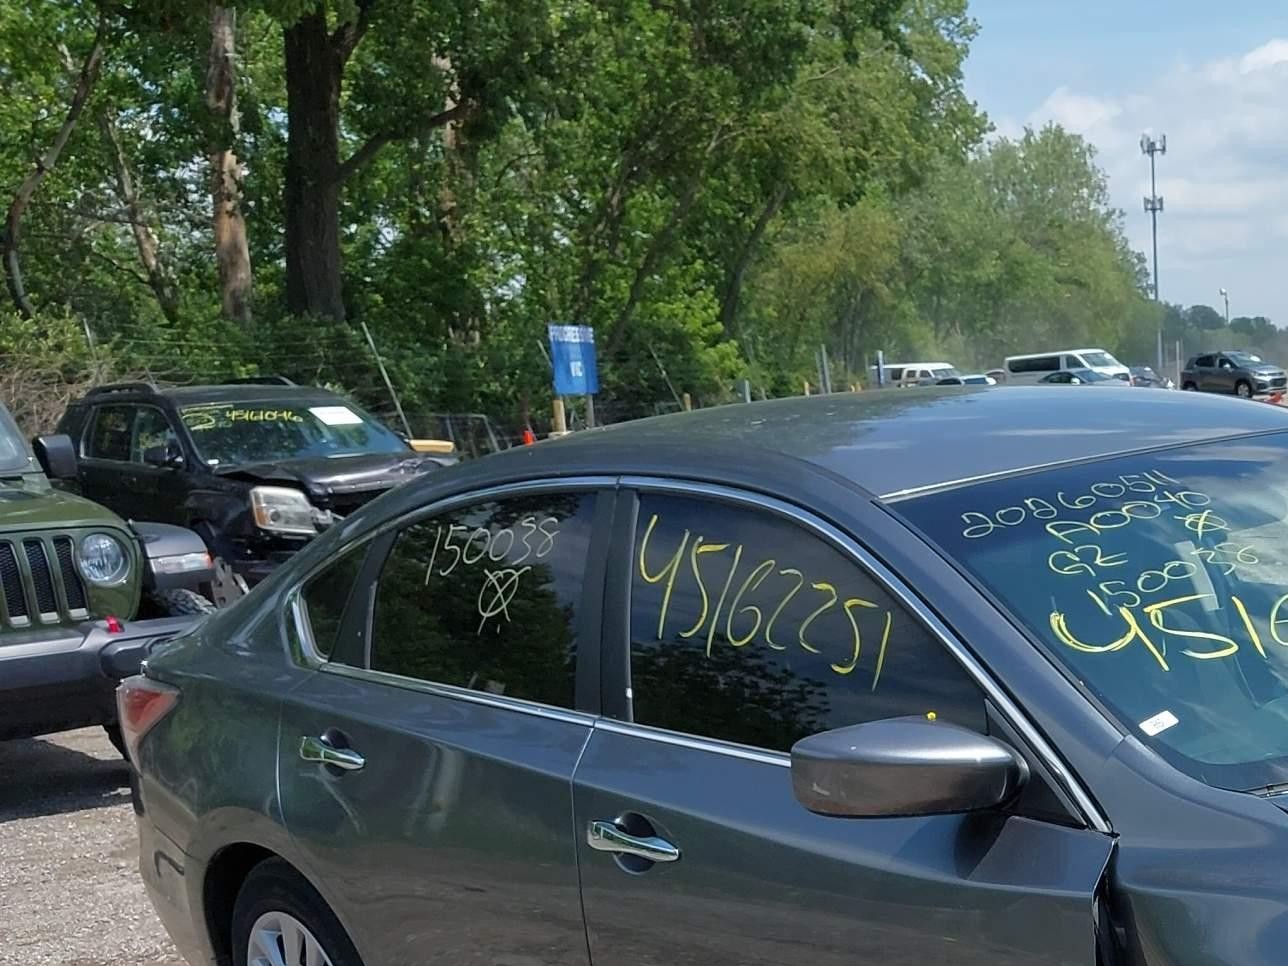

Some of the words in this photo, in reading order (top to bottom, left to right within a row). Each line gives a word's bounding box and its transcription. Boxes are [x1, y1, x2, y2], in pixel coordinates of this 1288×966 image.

[962, 469, 1180, 538] 20260511
[1046, 491, 1211, 544] A0040
[425, 517, 560, 585] 150038
[639, 514, 892, 691] 45162251
